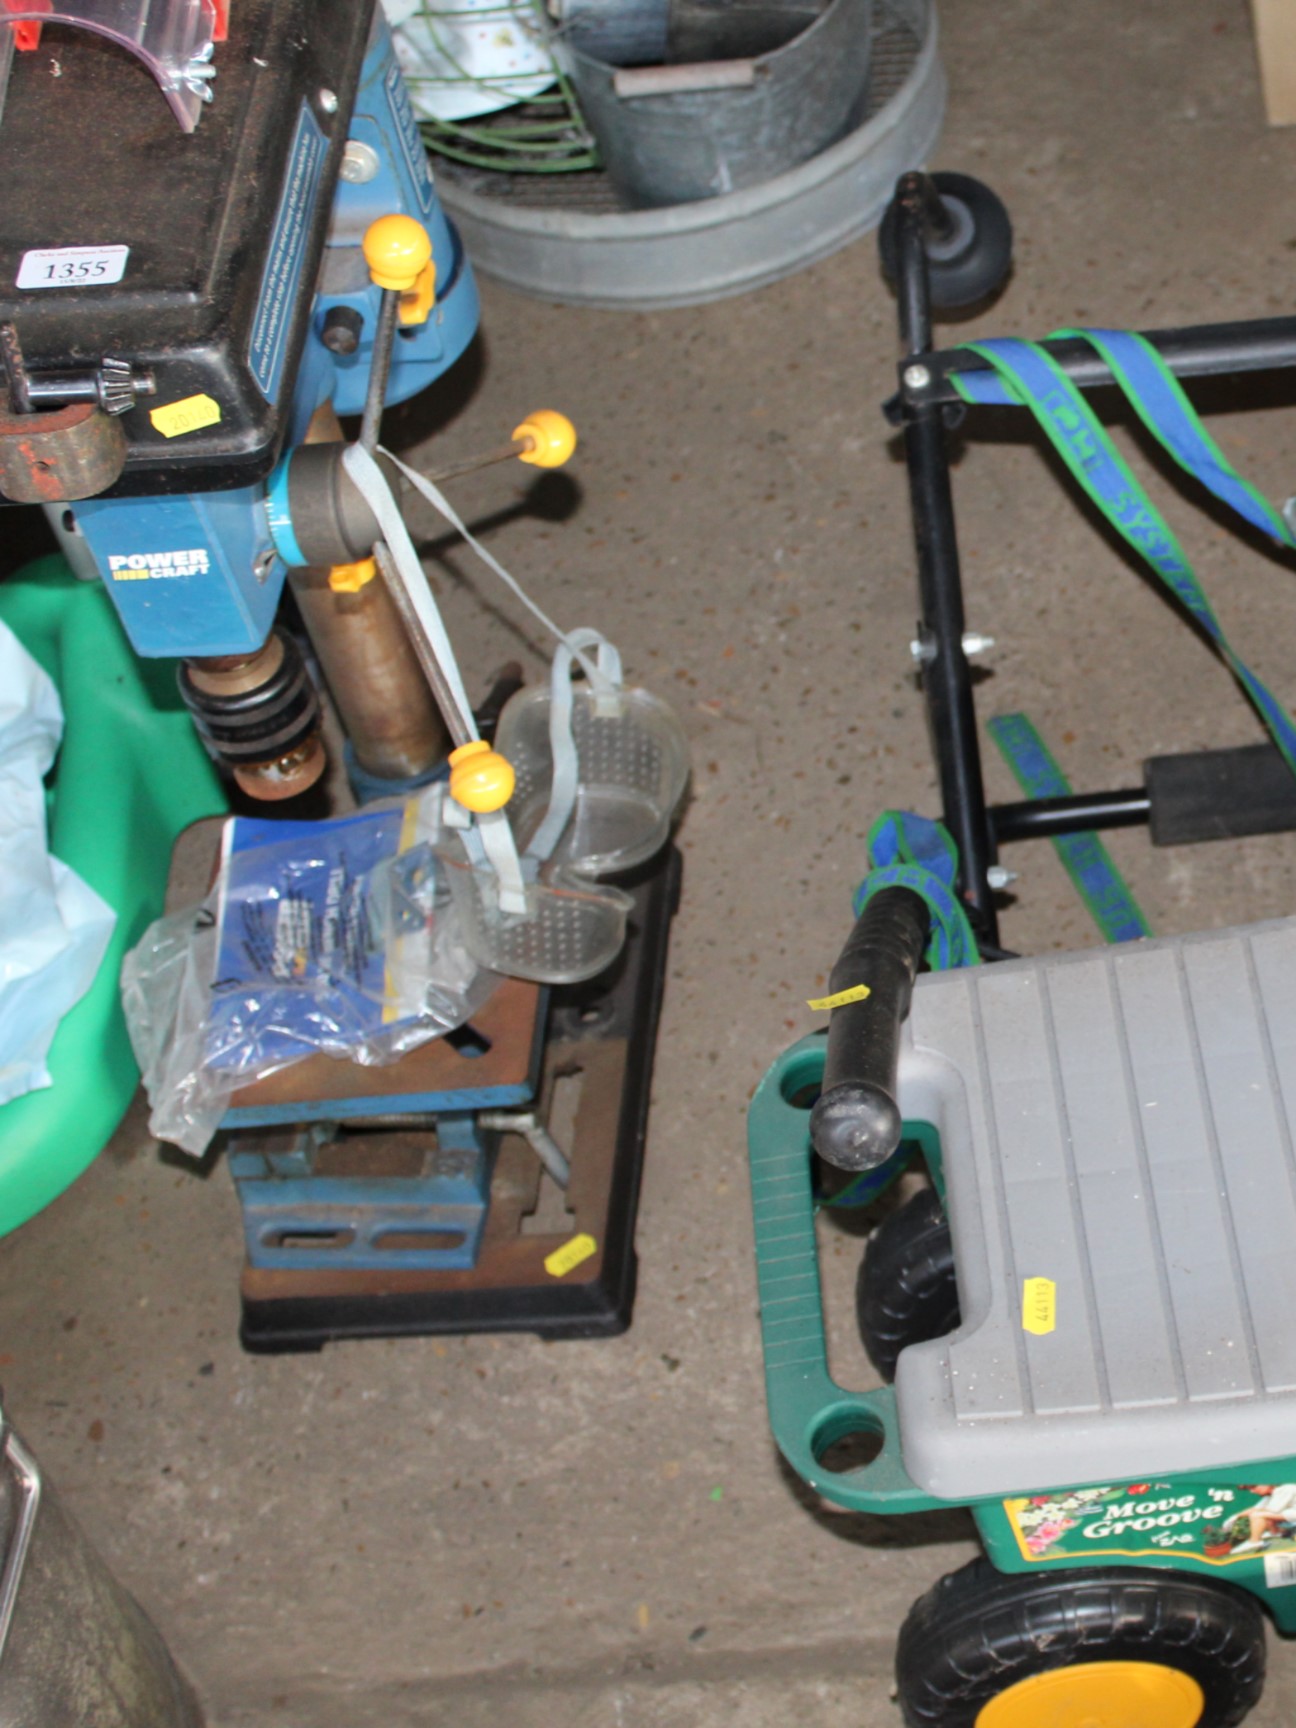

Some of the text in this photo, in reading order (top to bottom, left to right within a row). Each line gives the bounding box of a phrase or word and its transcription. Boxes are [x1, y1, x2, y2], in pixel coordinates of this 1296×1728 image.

[43, 260, 109, 280] 1355
[108, 549, 209, 570] POWER
[150, 563, 210, 579] CRAFT
[1034, 1282, 1049, 1321] 44113
[1103, 1488, 1234, 1520] Move 'n
[1082, 1505, 1224, 1538] Groove
